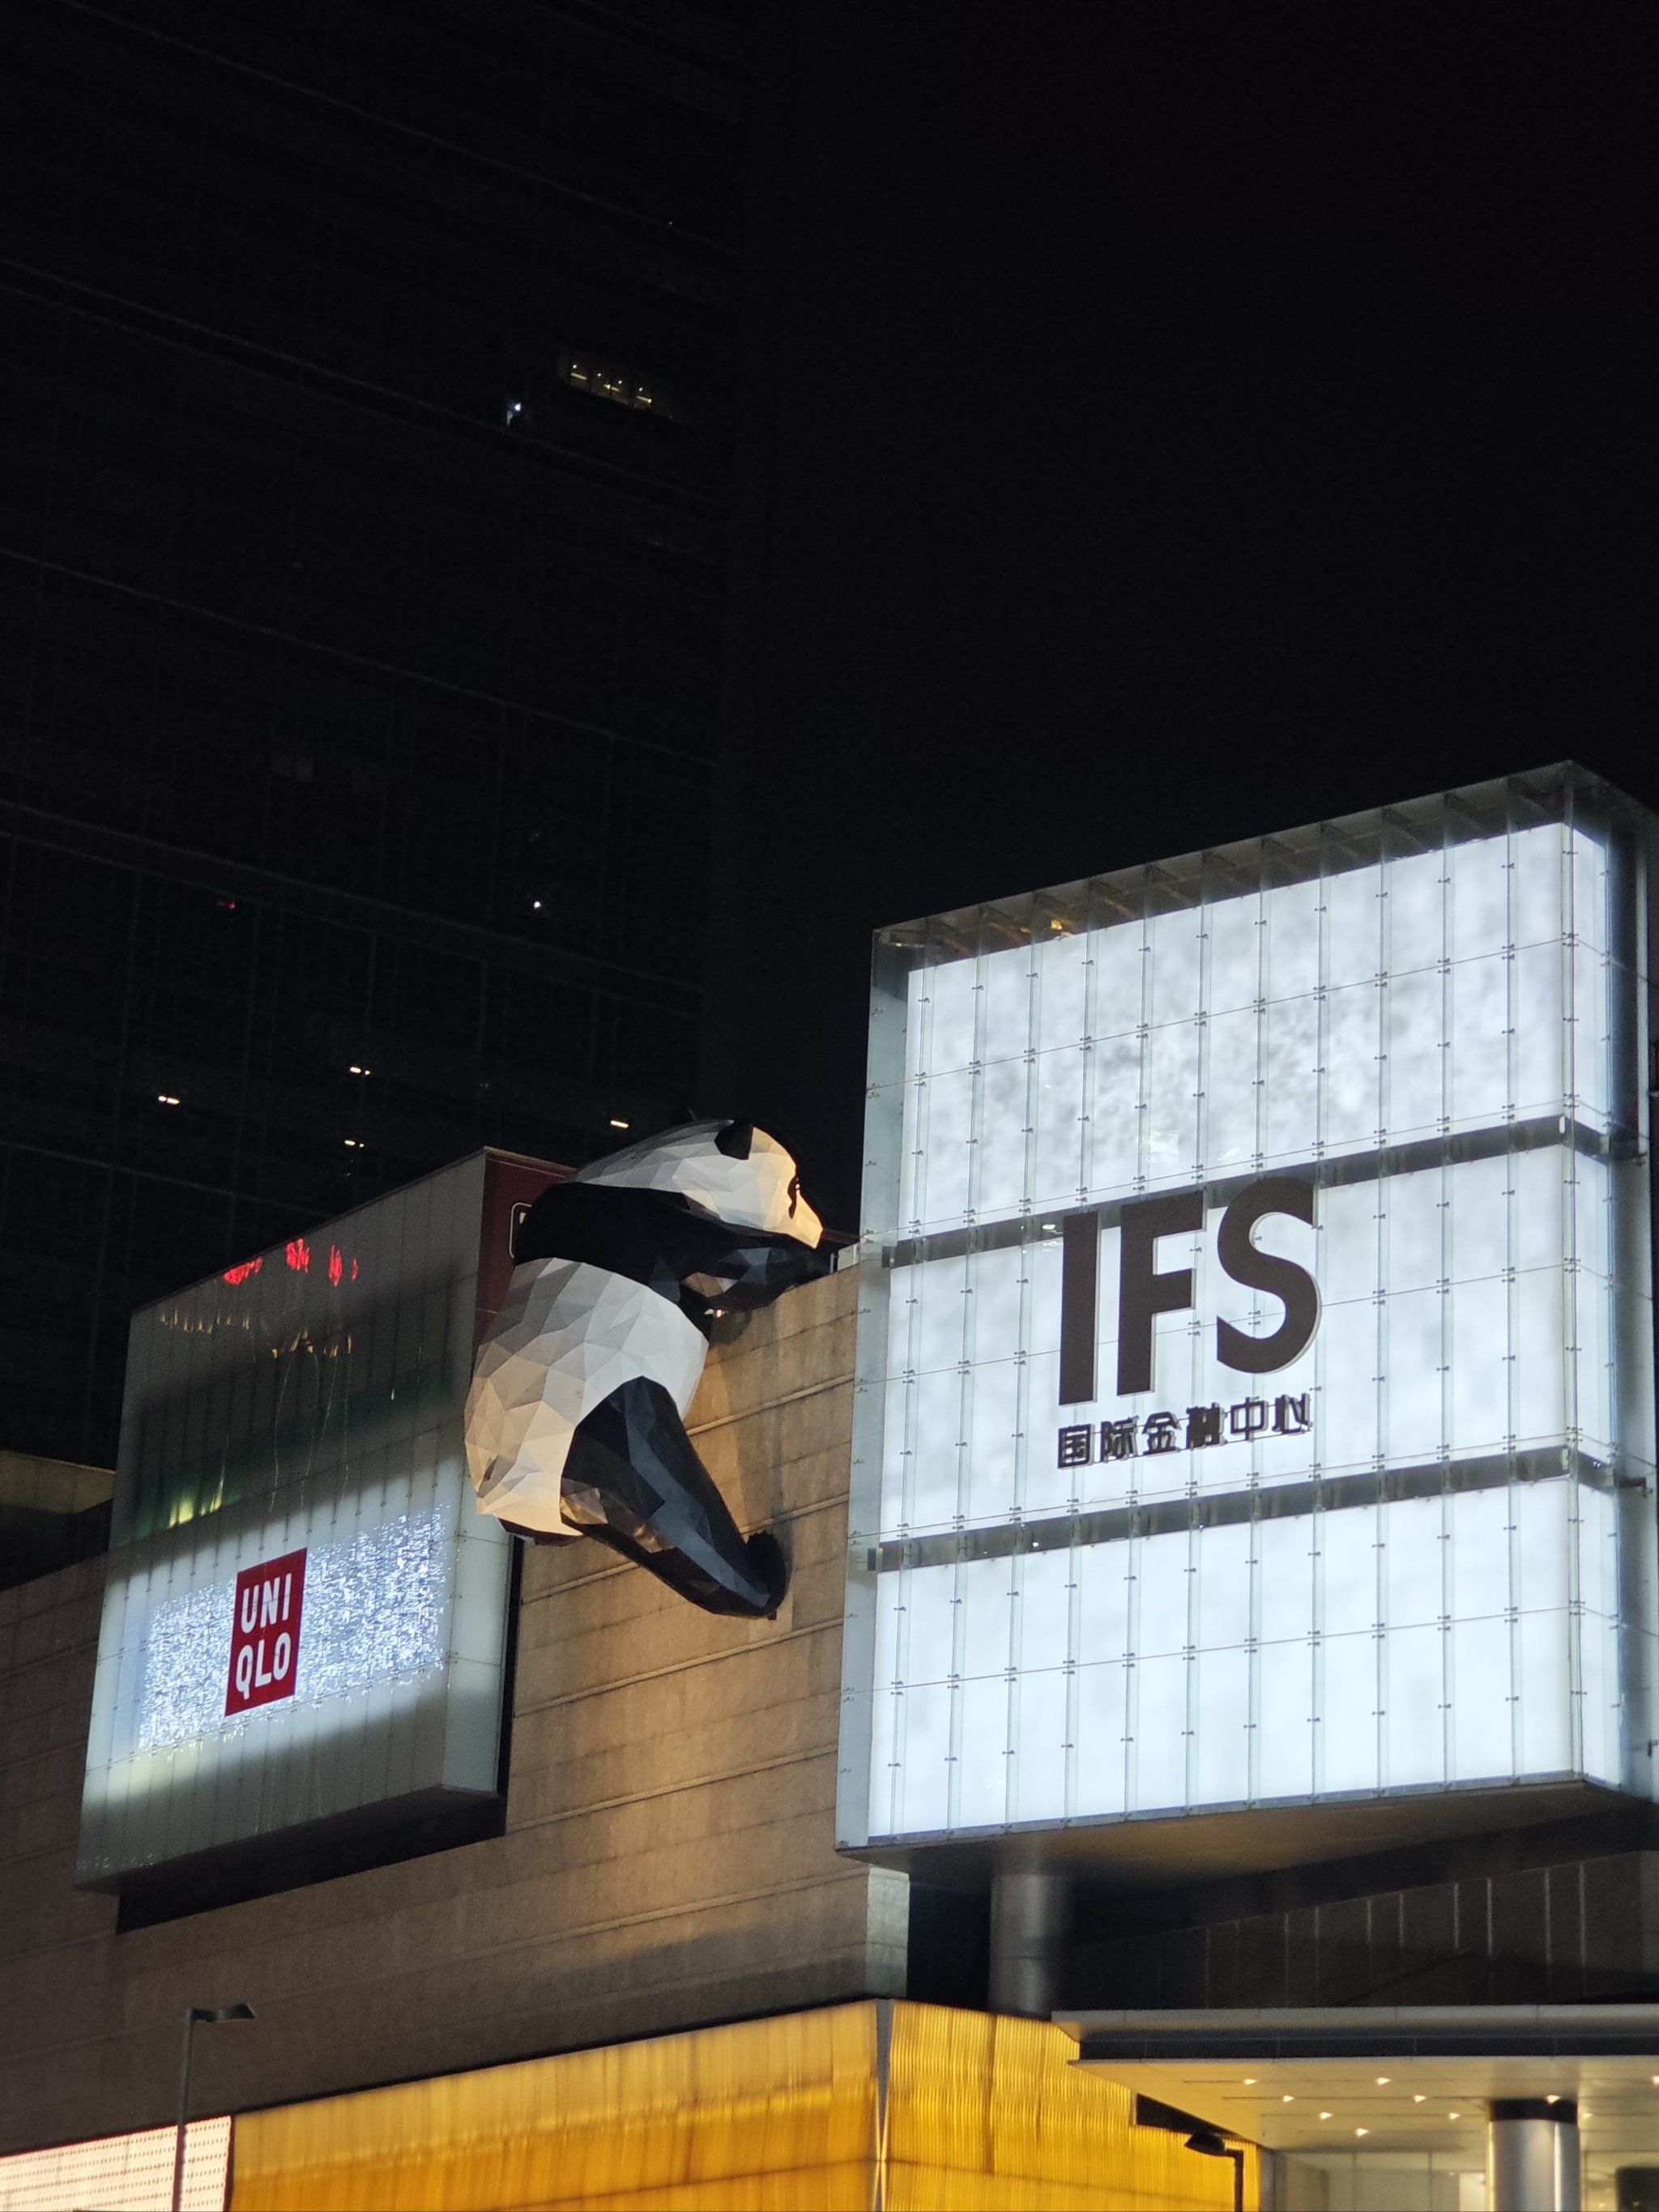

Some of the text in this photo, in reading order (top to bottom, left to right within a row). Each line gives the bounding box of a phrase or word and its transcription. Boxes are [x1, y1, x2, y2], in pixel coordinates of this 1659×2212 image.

[1059, 1176, 1322, 1407] IFS
[1057, 1393, 1313, 1469] 国际金融中心
[241, 1572, 292, 1634] UNI
[236, 1632, 292, 1700] QLO
